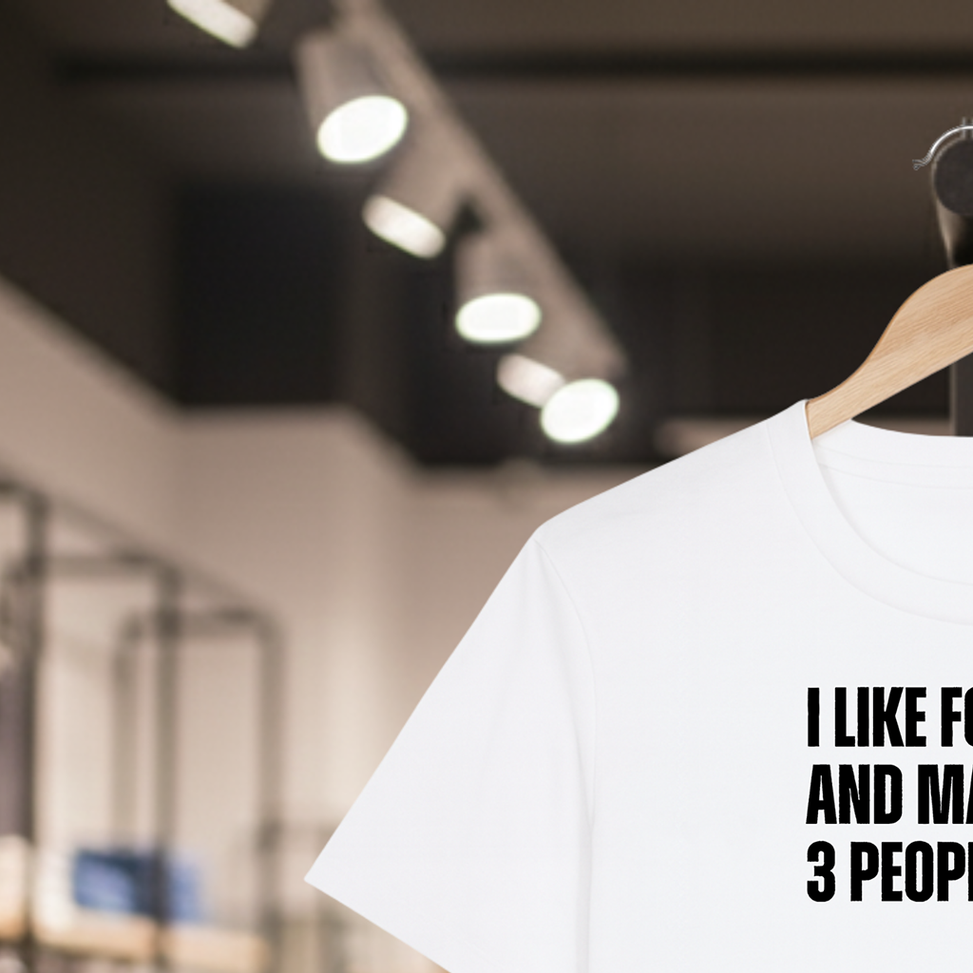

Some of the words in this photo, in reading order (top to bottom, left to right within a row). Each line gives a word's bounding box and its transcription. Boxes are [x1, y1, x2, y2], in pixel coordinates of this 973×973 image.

[807, 686, 820, 747] I
[834, 686, 927, 747] LIKE
[806, 764, 903, 824] AND
[806, 840, 836, 902] 3
